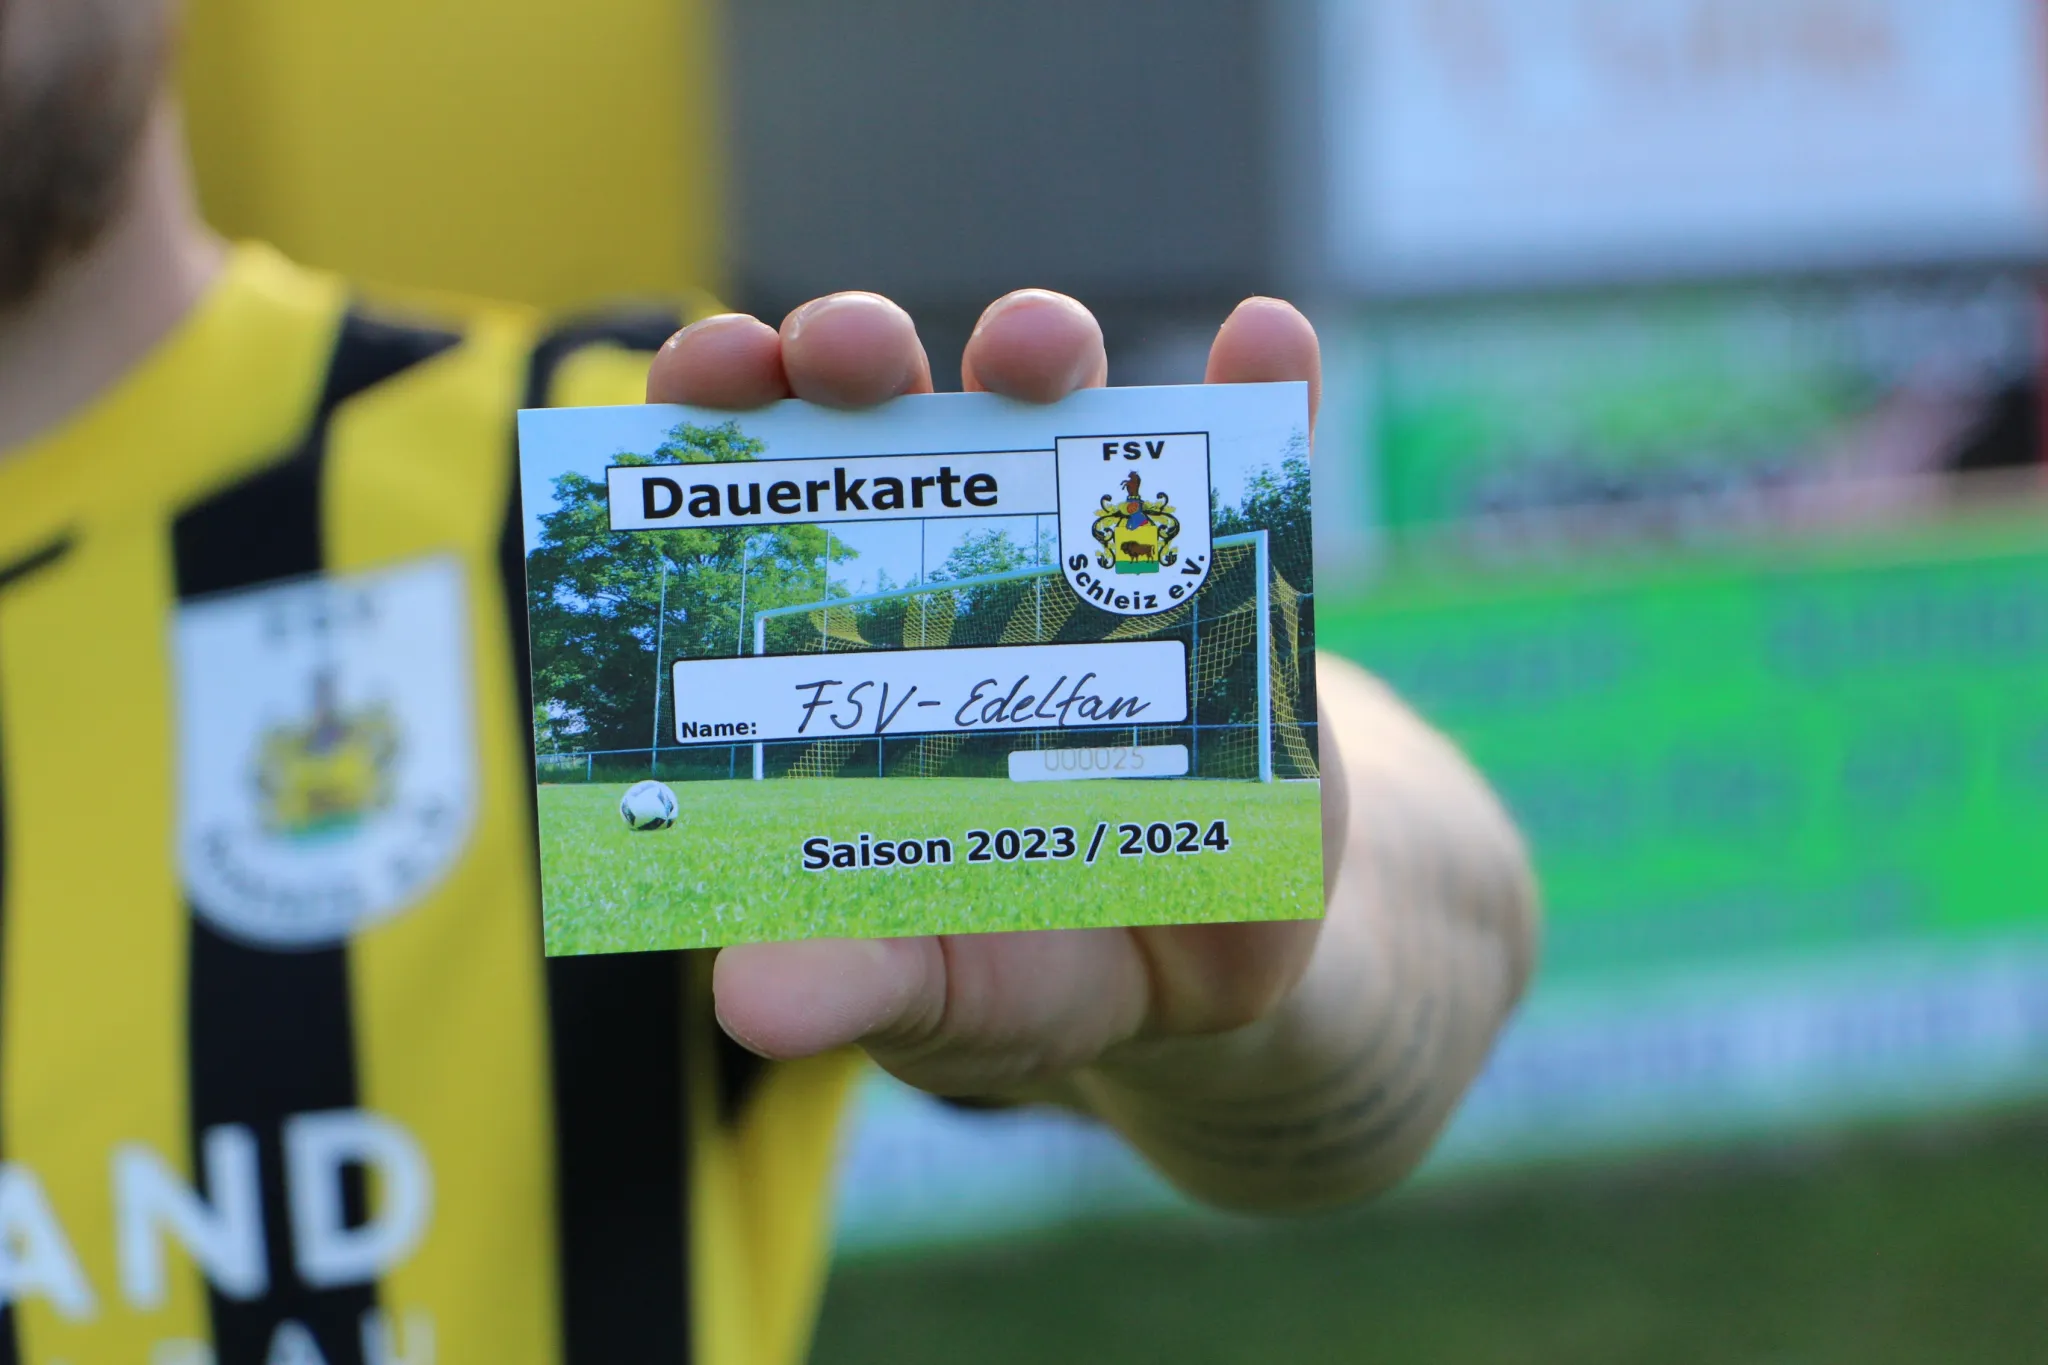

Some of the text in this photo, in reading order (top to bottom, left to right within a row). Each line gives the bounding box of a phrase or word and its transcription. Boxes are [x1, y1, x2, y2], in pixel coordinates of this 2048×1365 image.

[1103, 440, 1165, 461] FSV
[642, 466, 999, 520] Dauerkarte
[1069, 553, 1205, 610] Schleiz e.V.
[681, 718, 758, 739] Name:
[1044, 746, 1145, 771] 000025
[803, 834, 952, 870] Saison
[966, 826, 1077, 862] 2023
[1118, 820, 1230, 855] 2024
